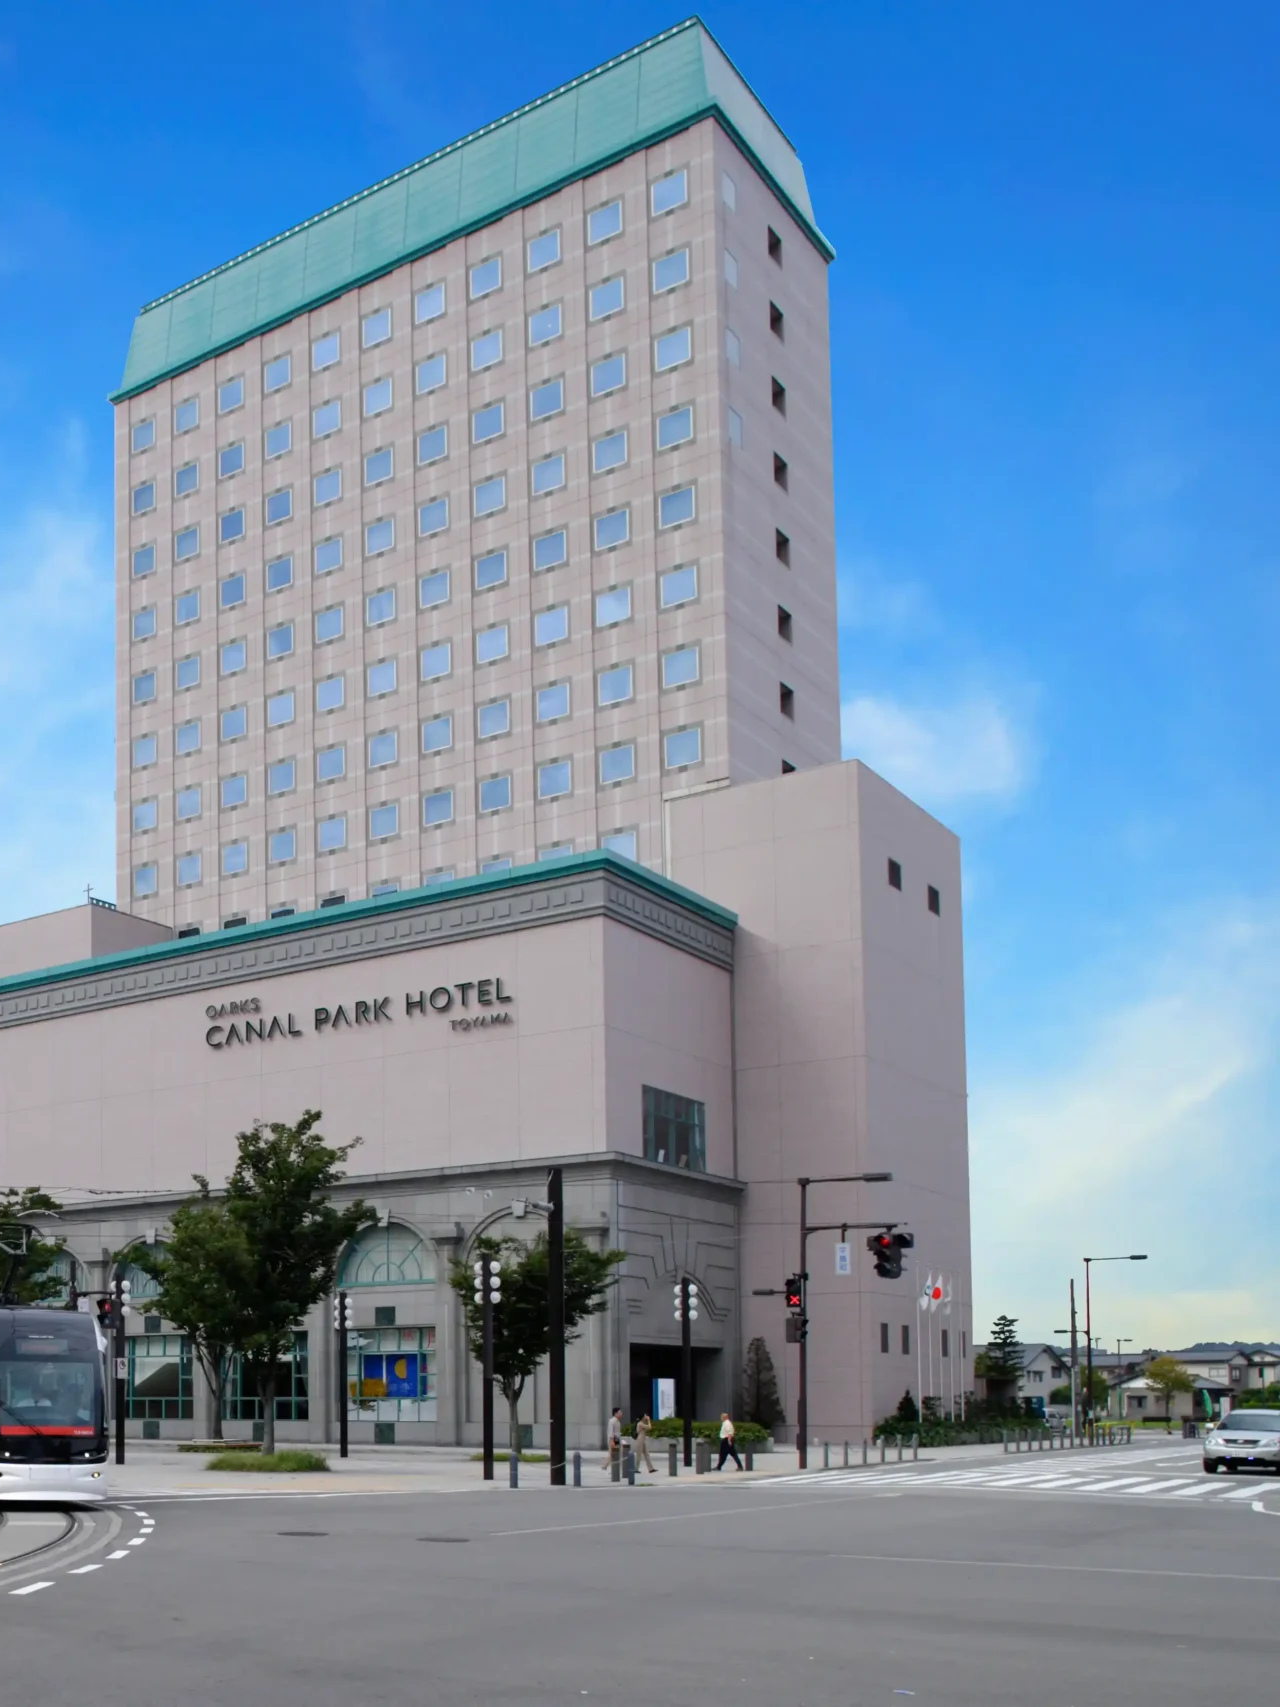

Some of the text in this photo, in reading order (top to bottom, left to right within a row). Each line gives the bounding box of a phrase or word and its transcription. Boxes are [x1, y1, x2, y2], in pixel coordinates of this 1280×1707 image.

[206, 997, 261, 1019] OARKS
[206, 977, 512, 1048] CANAL PARK HOTEL
[449, 1012, 513, 1031] TOYAMA
